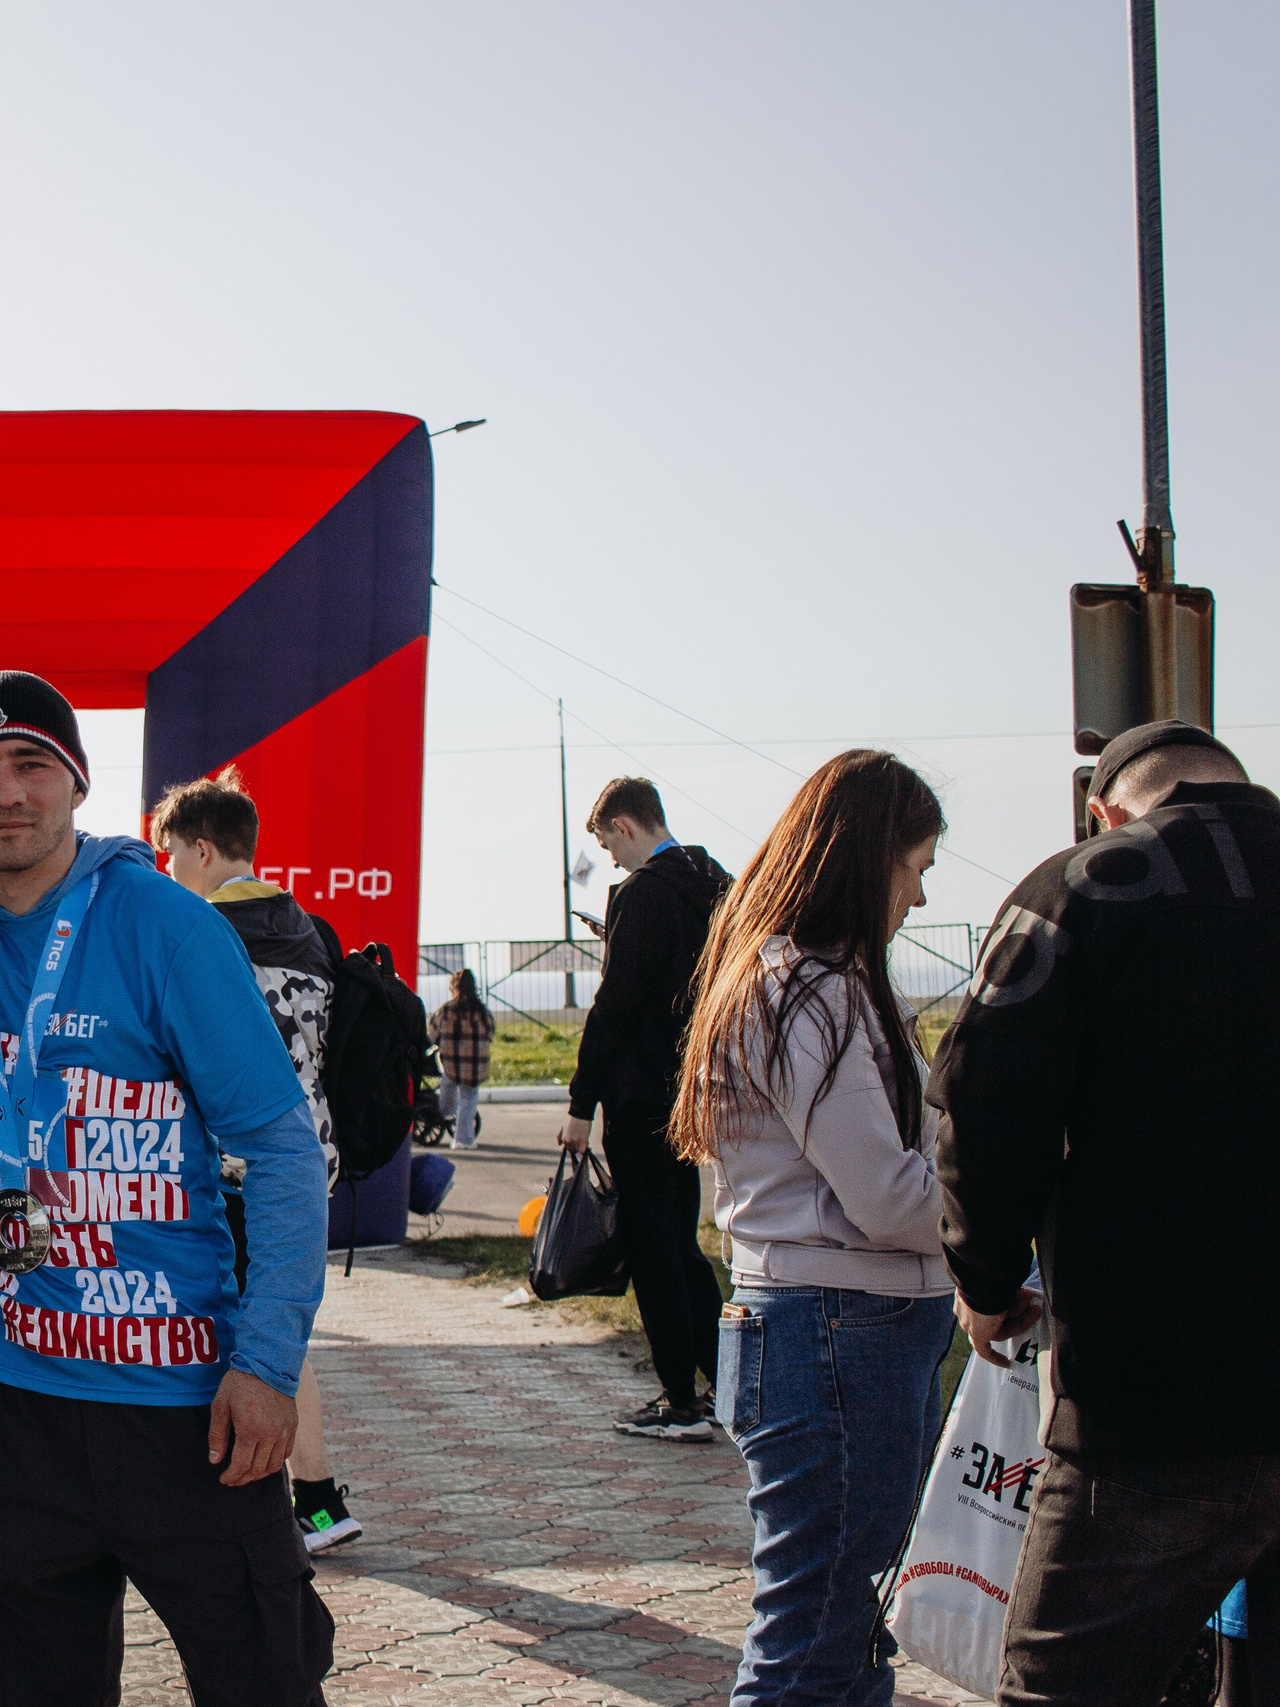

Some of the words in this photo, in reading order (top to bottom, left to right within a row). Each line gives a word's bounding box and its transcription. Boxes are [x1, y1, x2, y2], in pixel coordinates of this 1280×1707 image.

[45, 939, 65, 971] ПСБ
[65, 1067, 186, 1119] #ЦЕЛЬ
[75, 1269, 178, 1315] 2024
[0, 1294, 220, 1367] #ЕДИНСТВО
[970, 1498, 1016, 1528] Всероссийский
[909, 1561, 954, 1579] #СВОБОДА
